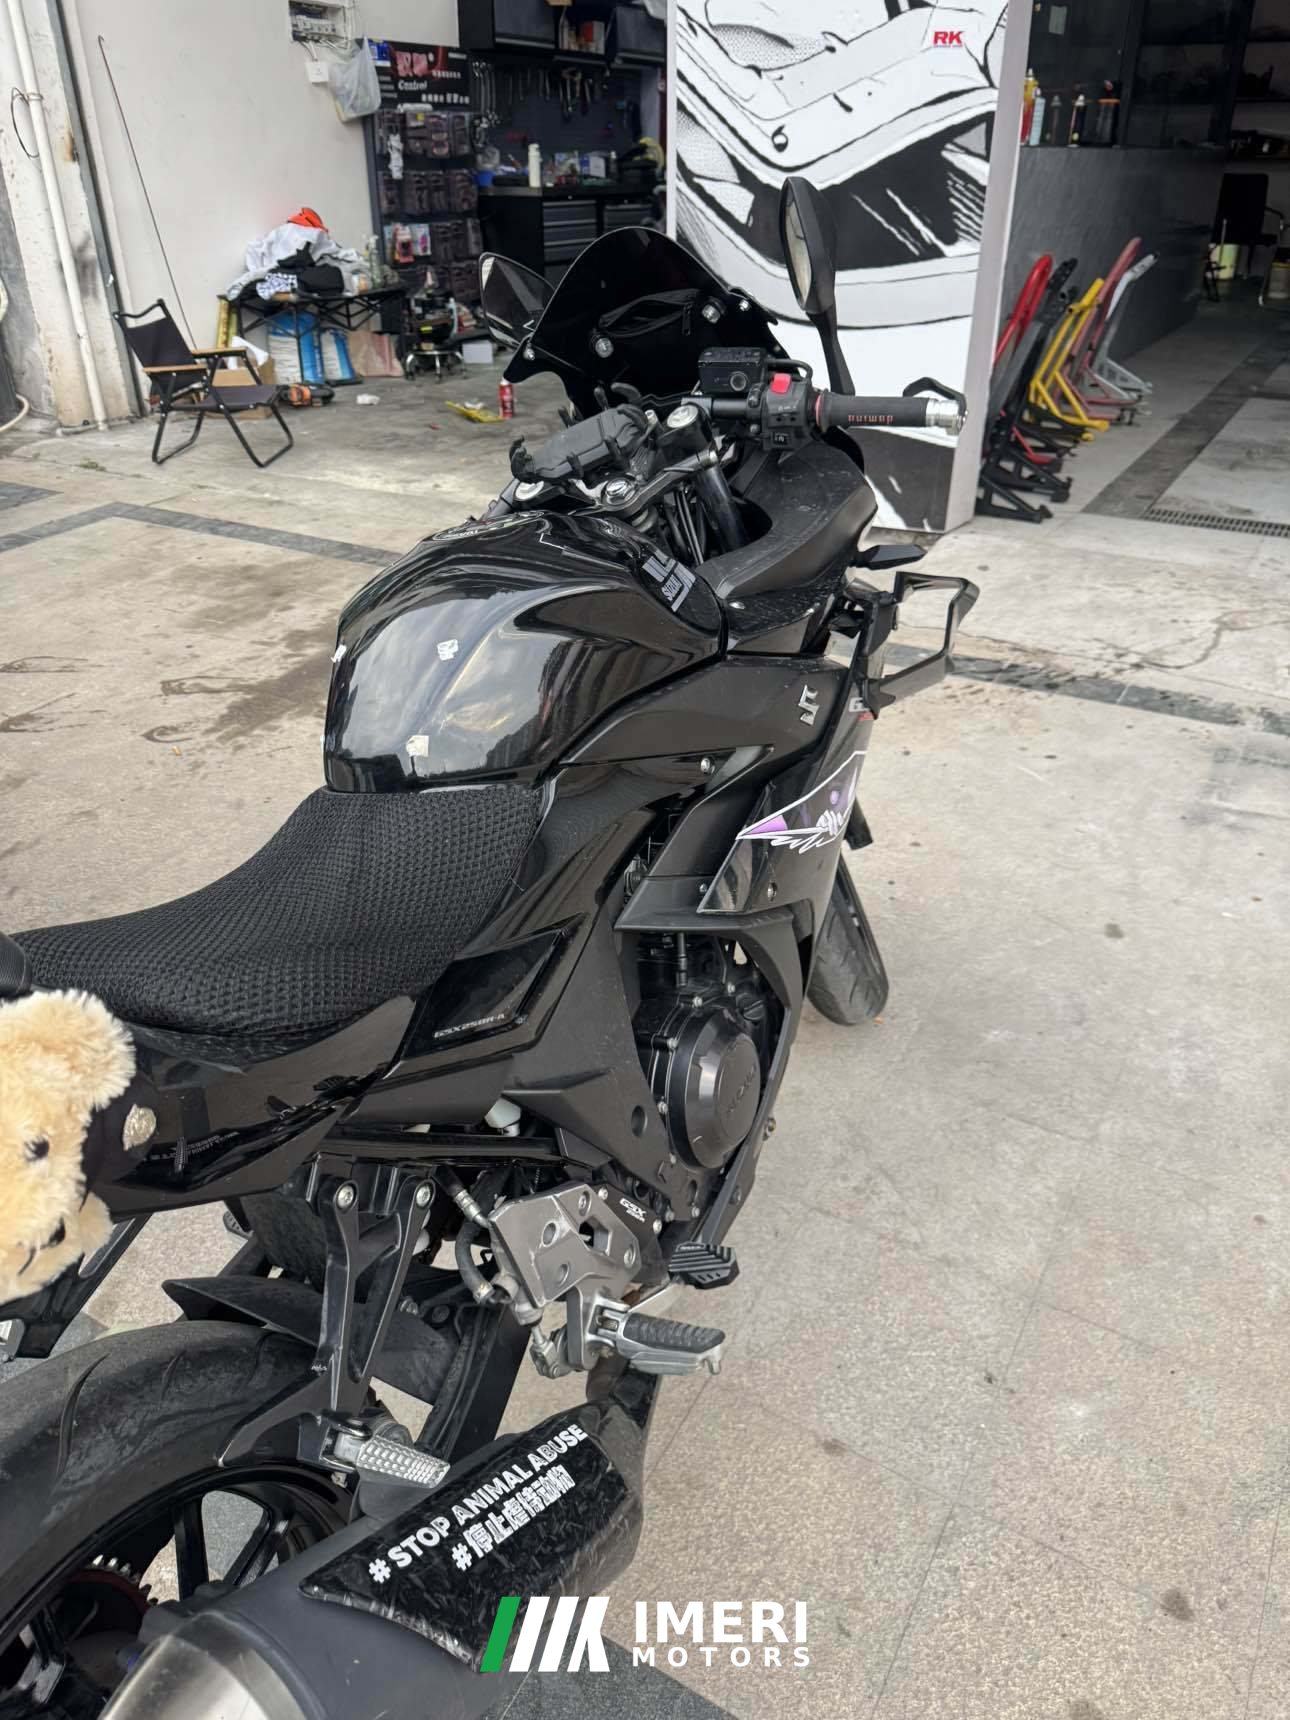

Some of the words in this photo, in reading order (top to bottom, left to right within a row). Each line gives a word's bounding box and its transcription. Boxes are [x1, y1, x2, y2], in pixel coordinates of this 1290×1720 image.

[934, 31, 964, 45] RK
[451, 1464, 534, 1526] ANIMAL
[527, 1424, 588, 1472] ABUSE
